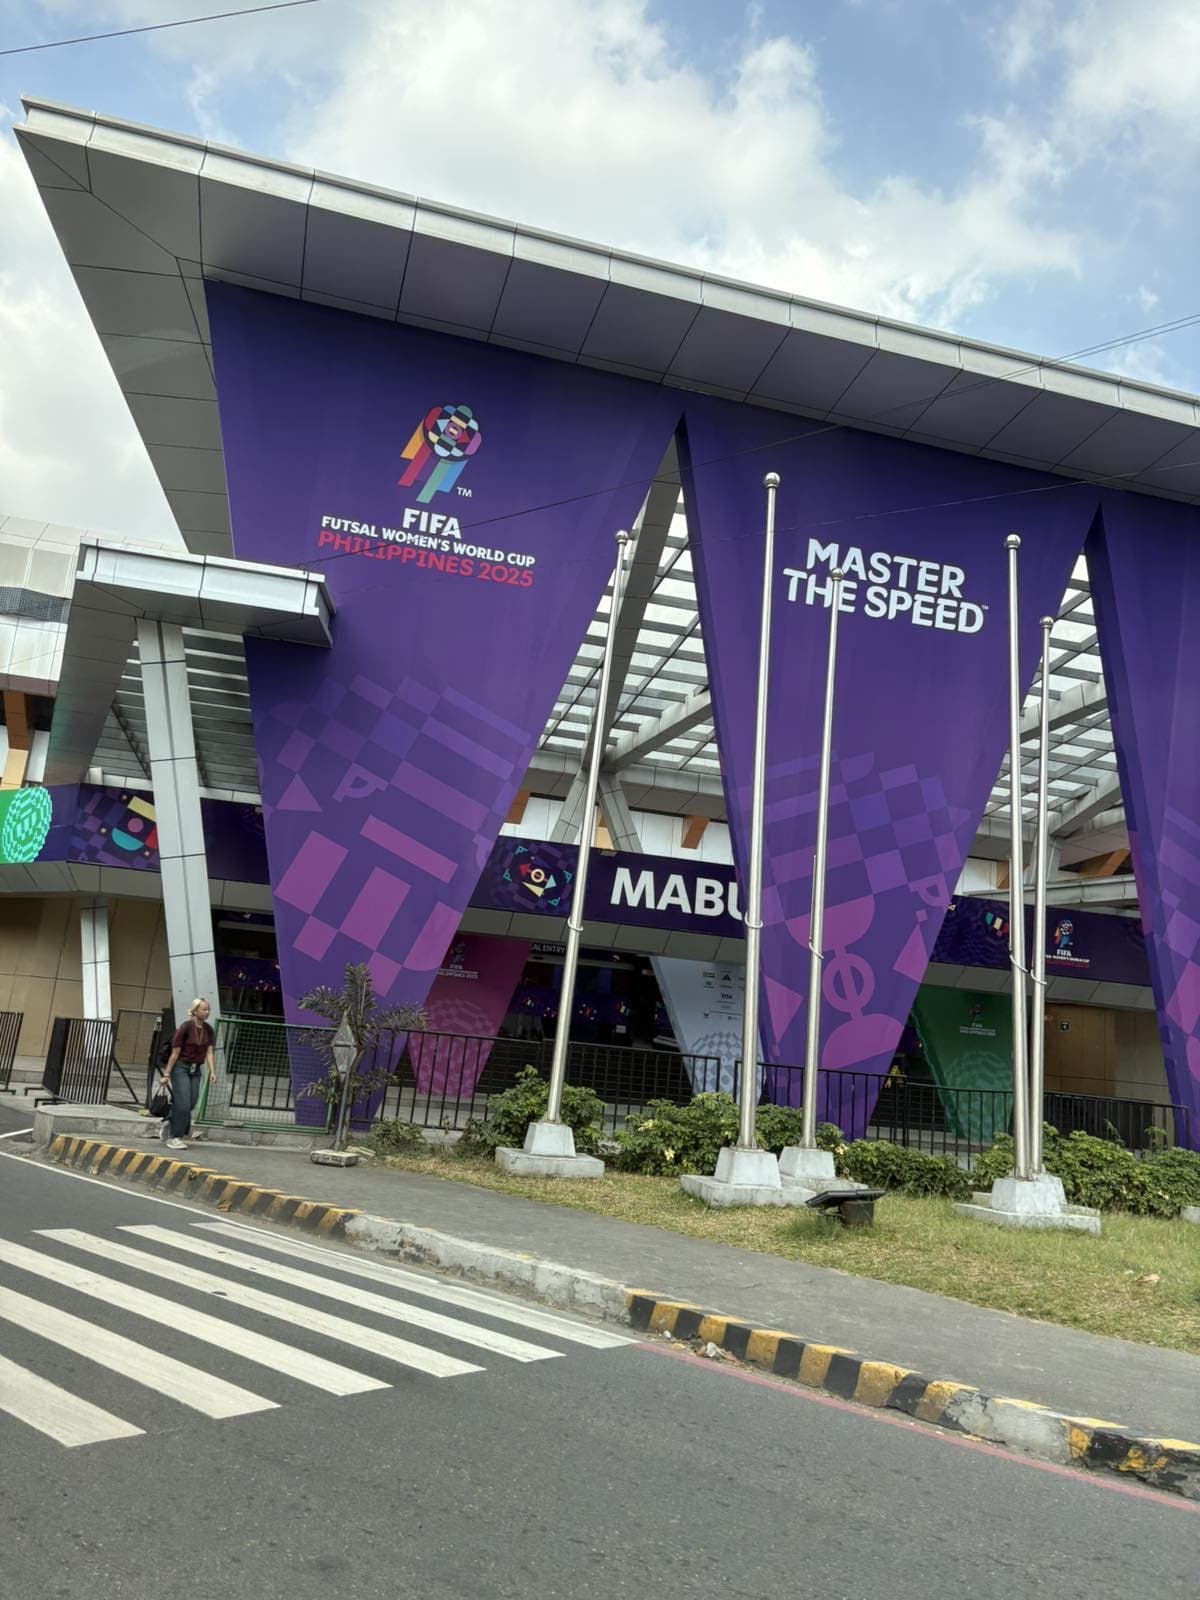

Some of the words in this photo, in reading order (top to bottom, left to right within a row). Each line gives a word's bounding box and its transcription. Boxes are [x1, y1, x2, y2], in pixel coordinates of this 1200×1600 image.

[321, 515, 378, 538] FUTSAL
[382, 527, 450, 552] WOMEN'S
[453, 541, 505, 562] WORLD
[507, 552, 536, 568] CUP
[402, 507, 462, 539] FIFA
[317, 530, 474, 577] PHILIPPINES
[476, 561, 534, 588] 2025
[806, 538, 965, 598] MASTER
[783, 567, 858, 613] THE
[864, 586, 985, 634] SPEED
